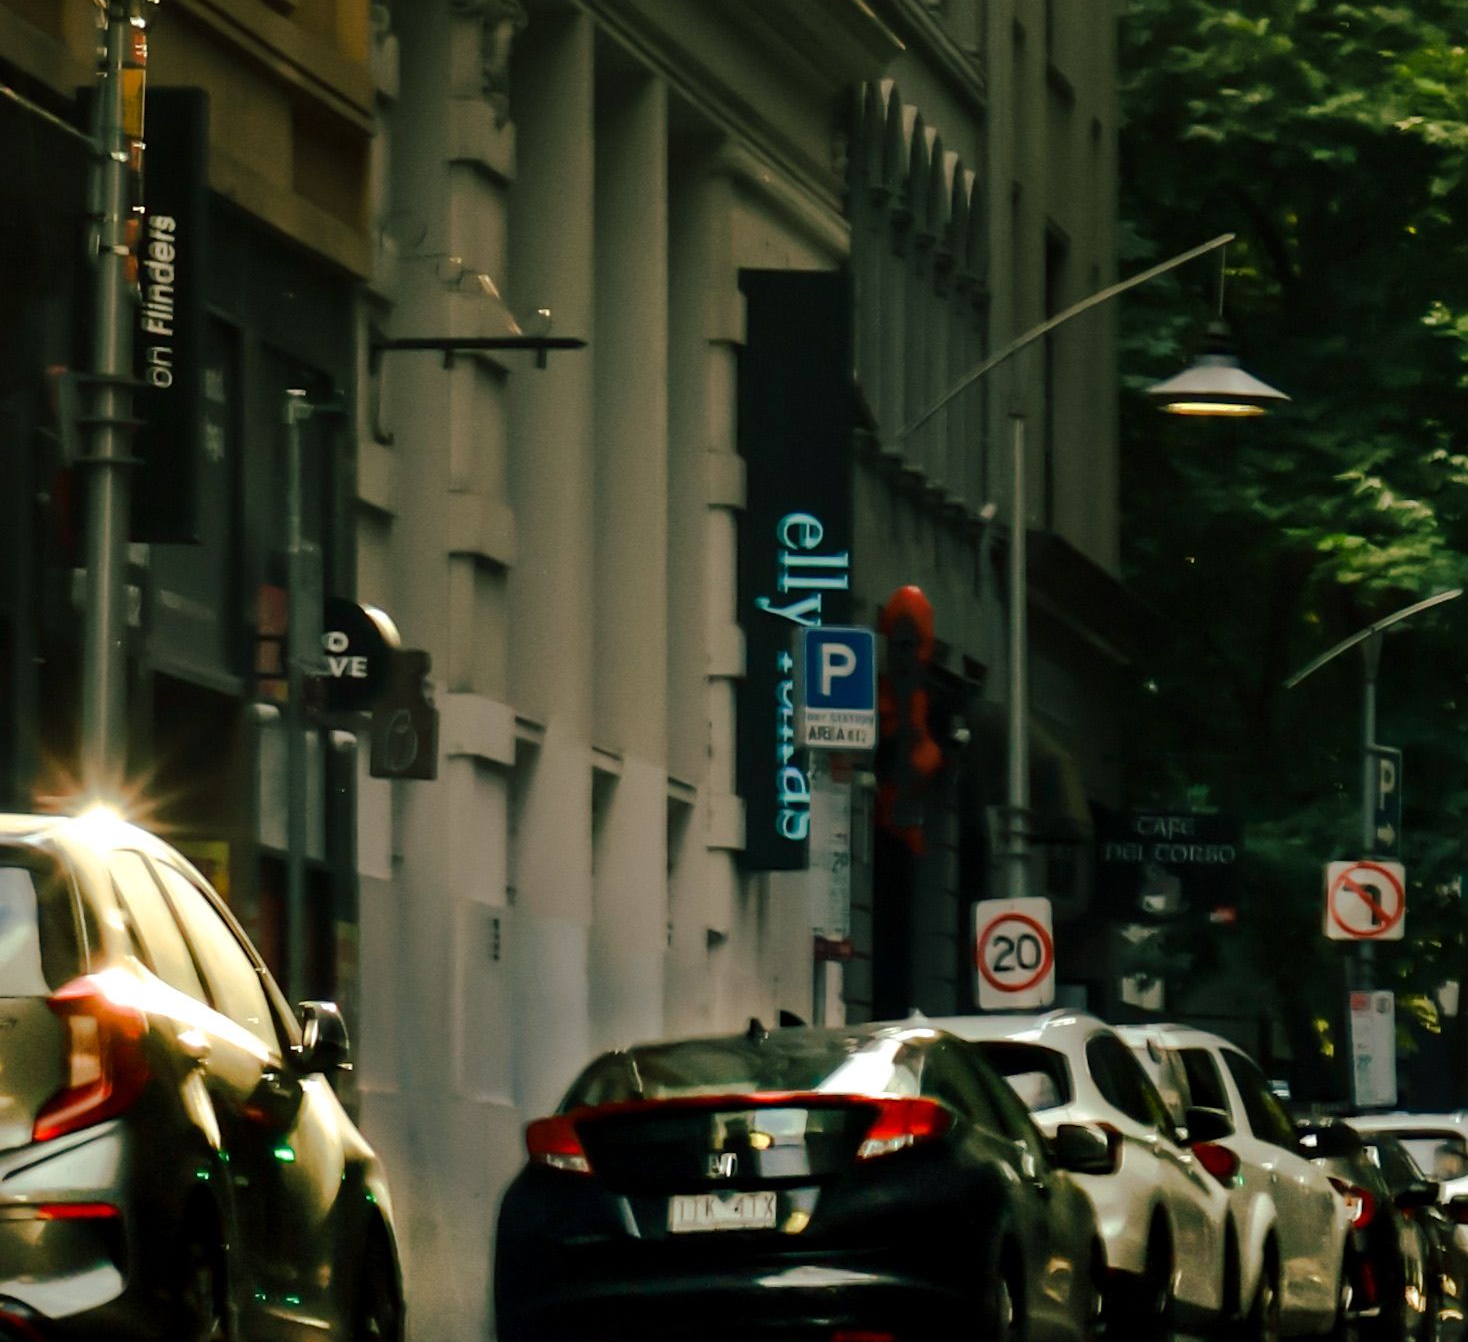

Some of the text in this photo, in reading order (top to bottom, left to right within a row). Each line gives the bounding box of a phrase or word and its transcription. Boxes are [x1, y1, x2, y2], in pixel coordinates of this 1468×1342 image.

[142, 215, 178, 390] on Flinders
[754, 512, 850, 627] elly
[818, 642, 857, 697] P
[992, 934, 1041, 973] 20
